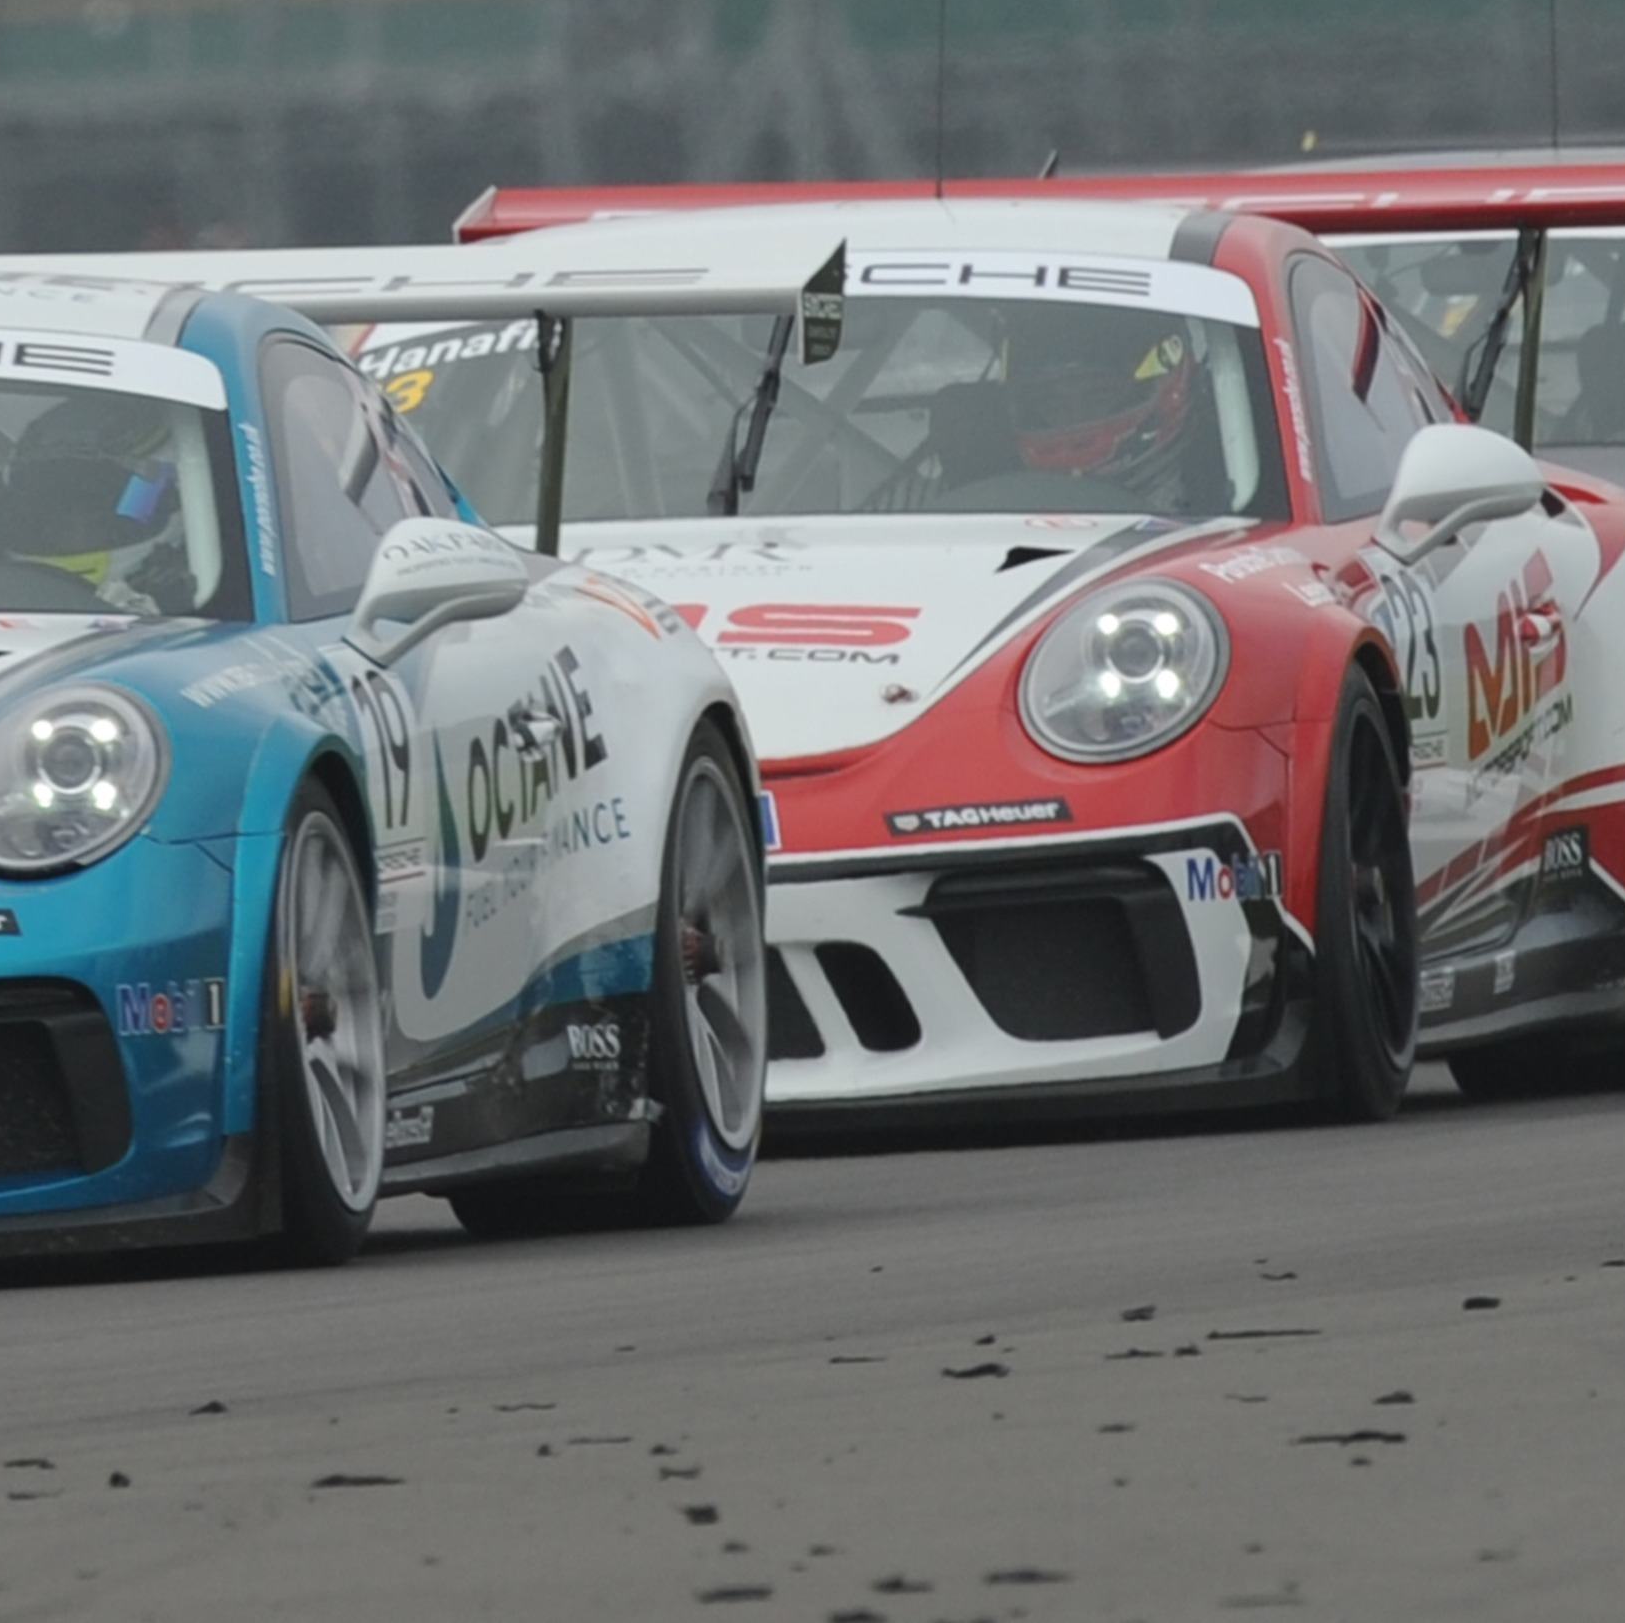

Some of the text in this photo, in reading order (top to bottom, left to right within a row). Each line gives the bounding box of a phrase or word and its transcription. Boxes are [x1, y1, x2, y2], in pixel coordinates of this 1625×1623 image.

[384, 369, 433, 414] 3
[1380, 571, 1441, 720] 23
[351, 669, 411, 829] 19
[468, 646, 609, 863] OCTANE
[567, 1024, 621, 1059] BOSS
